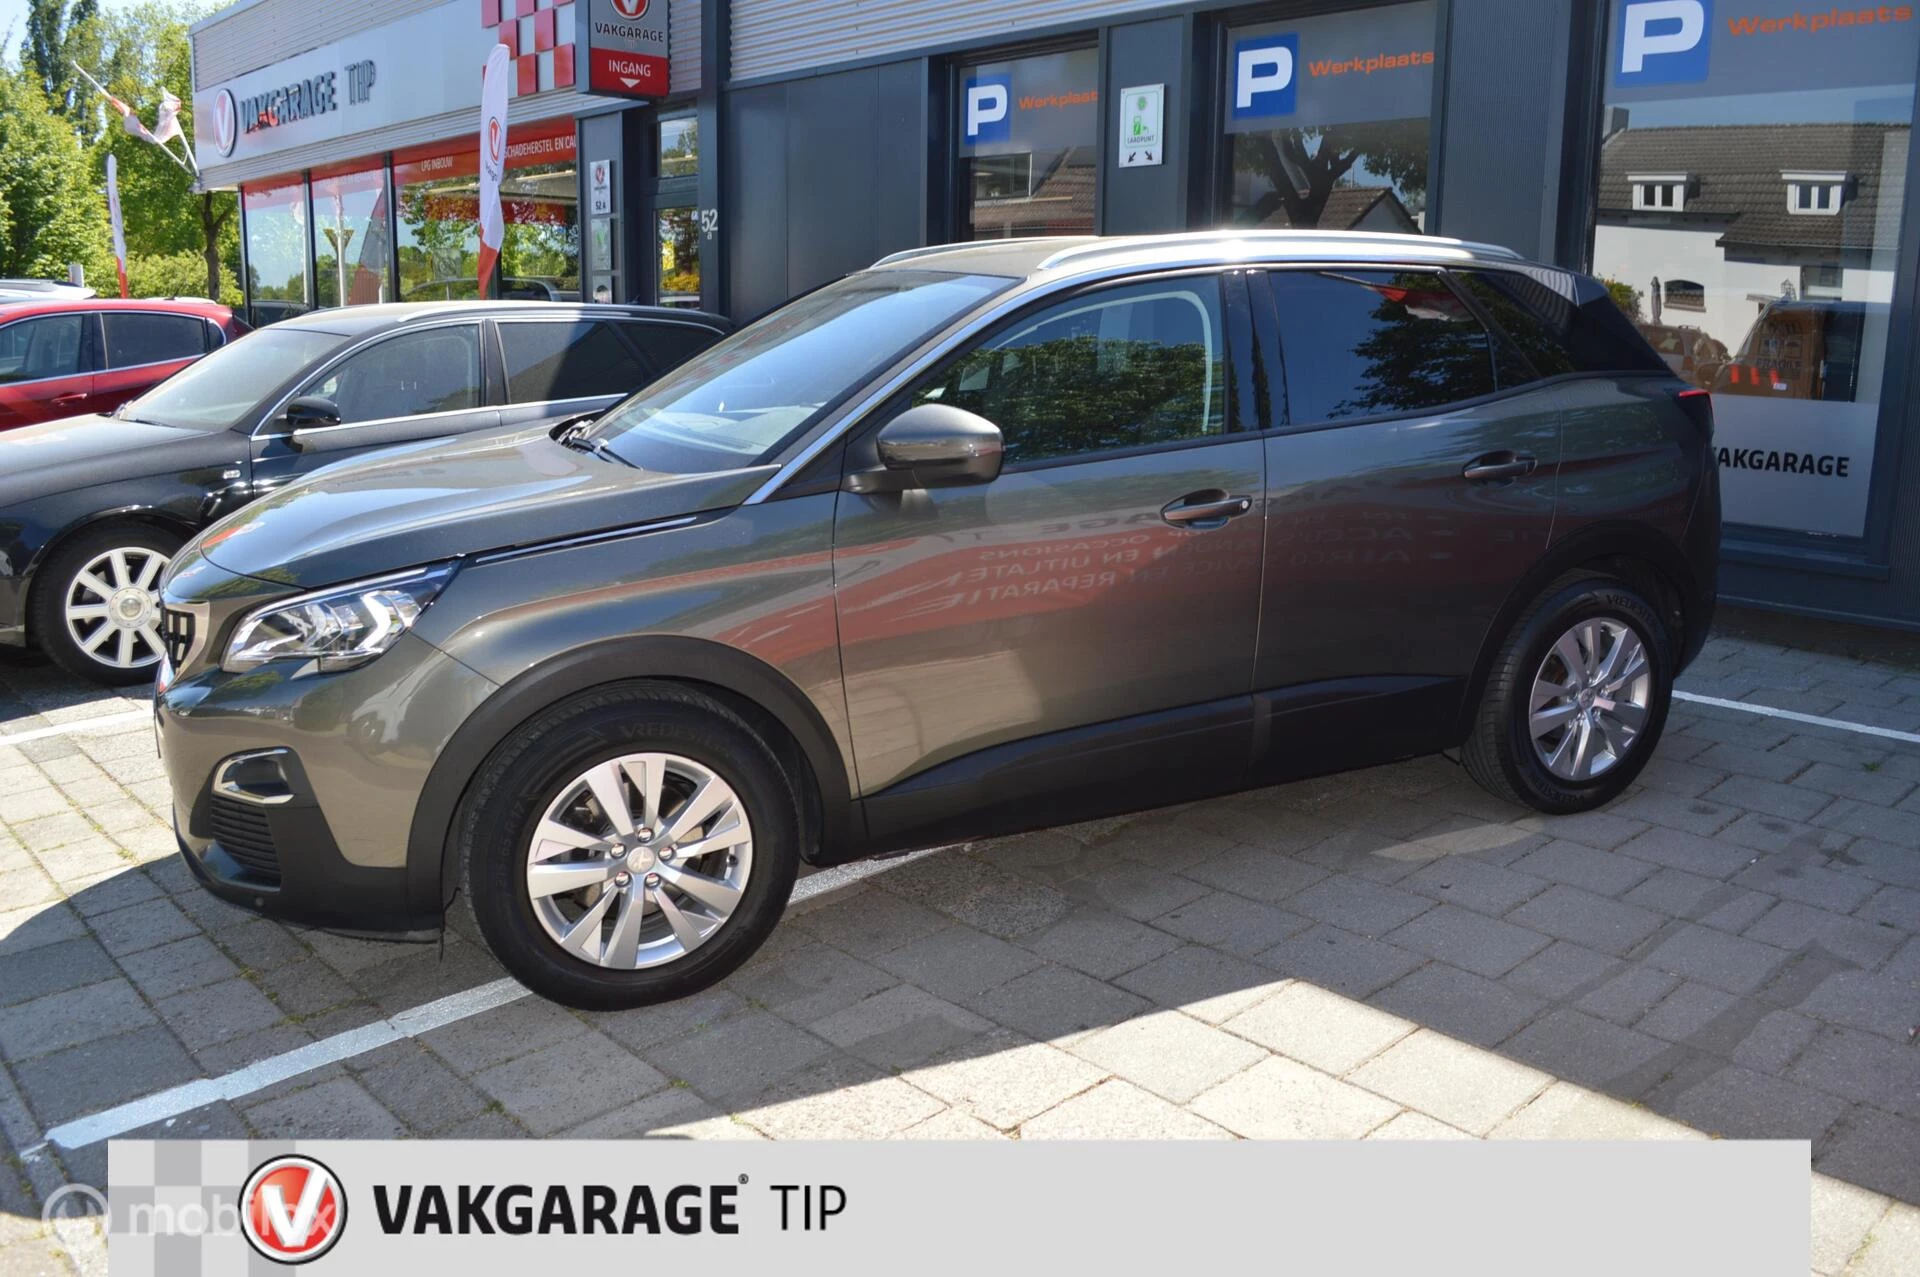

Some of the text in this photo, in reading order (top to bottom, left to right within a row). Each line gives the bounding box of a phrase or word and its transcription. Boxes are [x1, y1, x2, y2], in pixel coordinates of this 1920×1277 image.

[595, 22, 664, 42] VAKGARAGE
[1728, 5, 1914, 37] Werkplaats
[1621, 0, 1705, 74] P
[608, 59, 652, 77] INGANG
[1308, 51, 1435, 77] Werkplaats
[1236, 46, 1293, 109] P
[240, 60, 377, 134] VAKGARAGE TIP
[967, 84, 1008, 136] P
[1019, 88, 1098, 111] Werkplaat
[554, 137, 564, 151] EN
[421, 155, 454, 172] LPG INBOUW
[701, 208, 719, 233] 52
[1714, 447, 1850, 478] AKGARAGE
